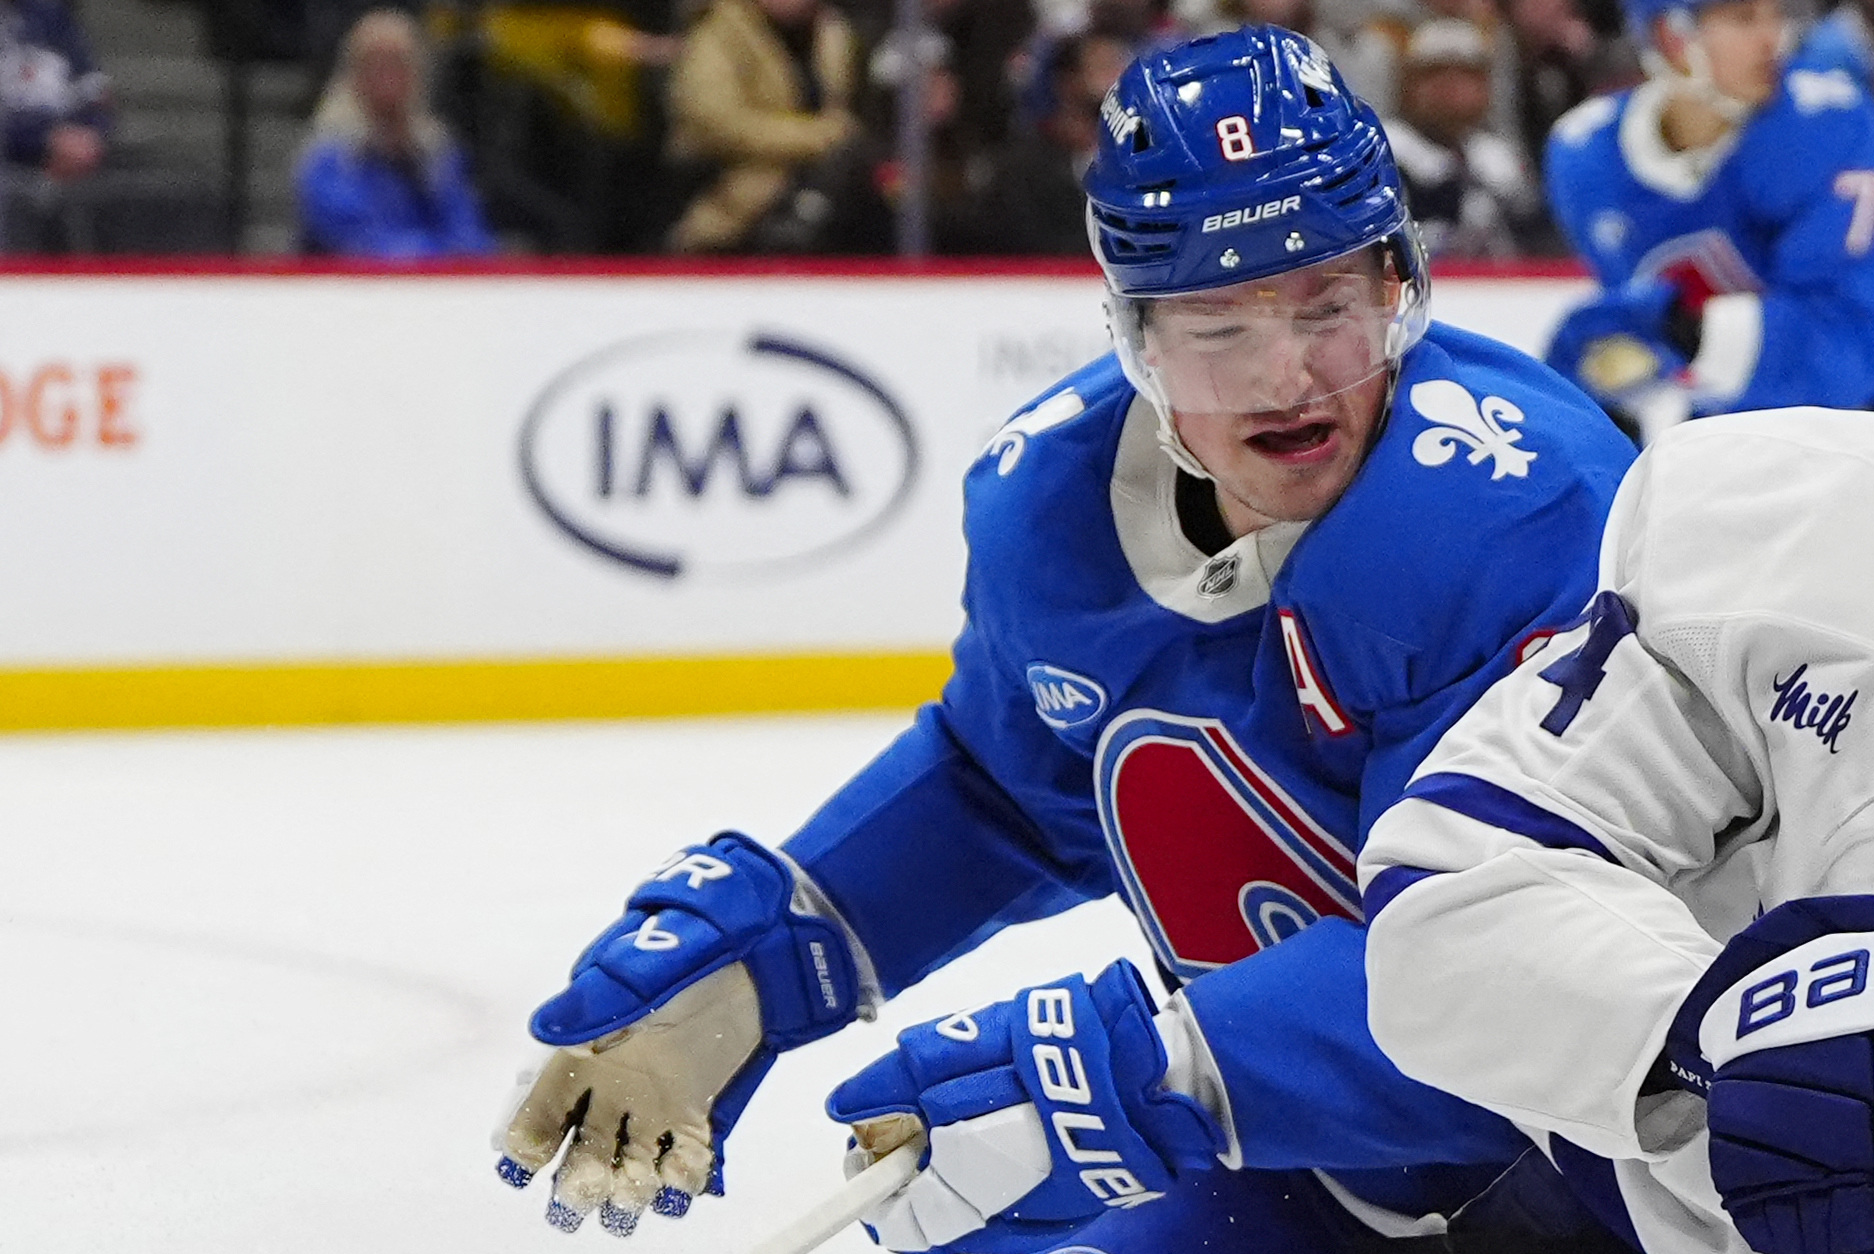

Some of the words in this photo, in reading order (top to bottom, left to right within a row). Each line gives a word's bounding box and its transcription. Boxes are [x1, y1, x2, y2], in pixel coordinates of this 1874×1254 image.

[1215, 114, 1256, 162] 8
[1201, 195, 1302, 233] BAUER
[595, 402, 852, 501] IMA
[1278, 609, 1354, 738] A
[1769, 663, 1860, 754] Milk
